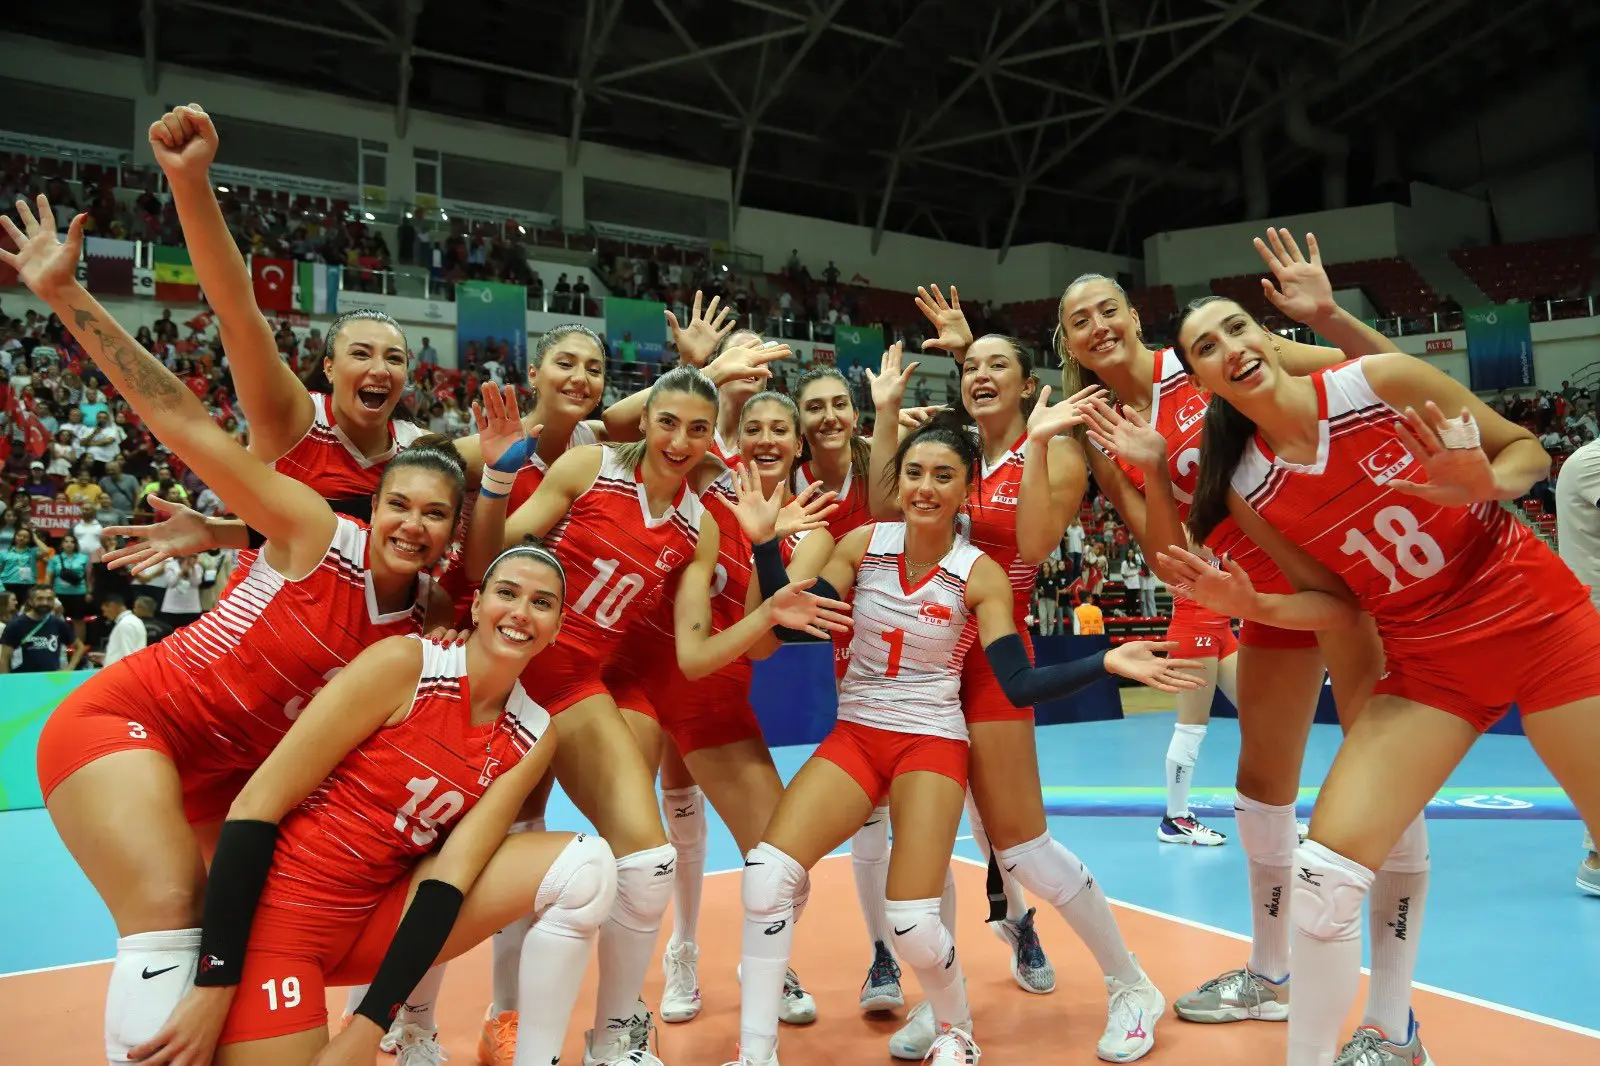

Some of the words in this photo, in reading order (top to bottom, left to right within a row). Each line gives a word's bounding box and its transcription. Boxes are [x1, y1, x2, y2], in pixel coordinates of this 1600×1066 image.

[1427, 341, 1440, 350] ALT
[1185, 412, 1204, 426] TUR
[1381, 461, 1406, 478] TUR
[1339, 505, 1446, 594] 18
[571, 557, 645, 629] 10
[924, 616, 943, 625] TUR
[881, 627, 905, 678] 1
[1194, 636, 1212, 647] 22
[127, 721, 147, 739] 3
[393, 775, 465, 847] 19
[1269, 886, 1282, 917] MIKASA
[1395, 897, 1410, 940] MIKASA
[261, 976, 301, 1011] 19
